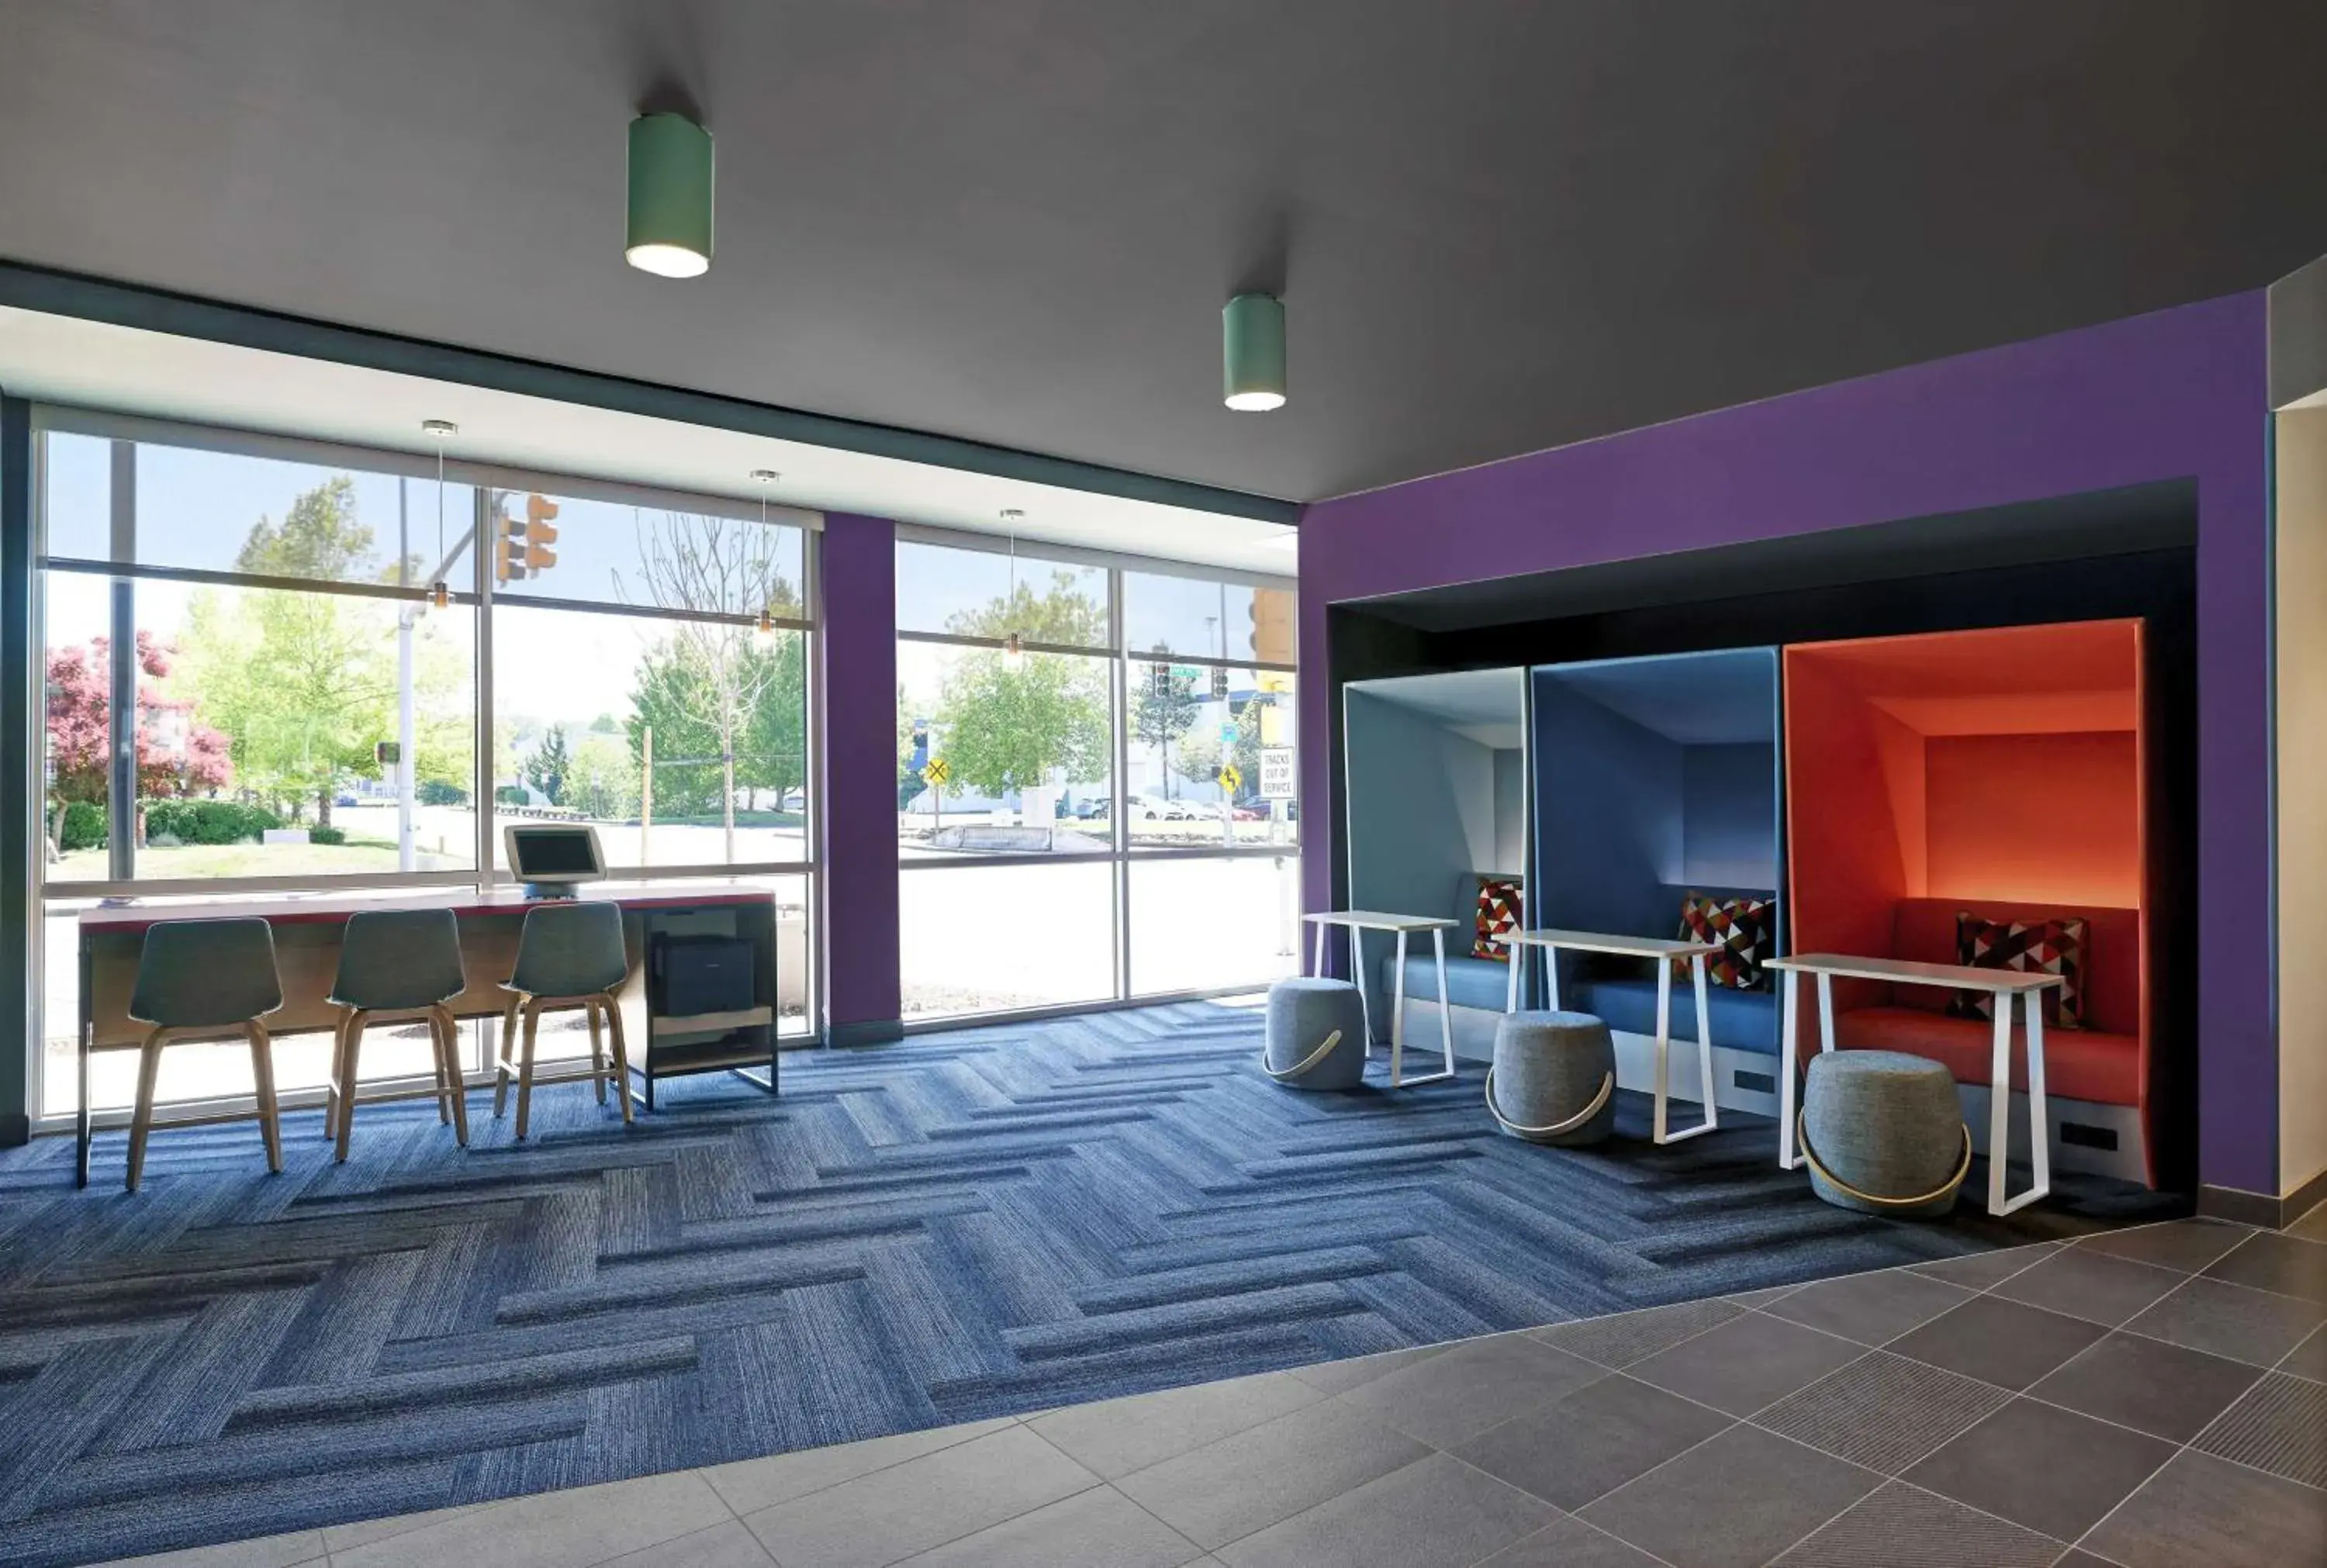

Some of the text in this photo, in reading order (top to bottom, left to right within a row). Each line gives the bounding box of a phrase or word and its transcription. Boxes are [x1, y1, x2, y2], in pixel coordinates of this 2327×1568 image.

[1264, 754, 1289, 765] TRACKS
[1265, 768, 1289, 779] OUT OF
[1264, 782, 1291, 793] SERVICE
